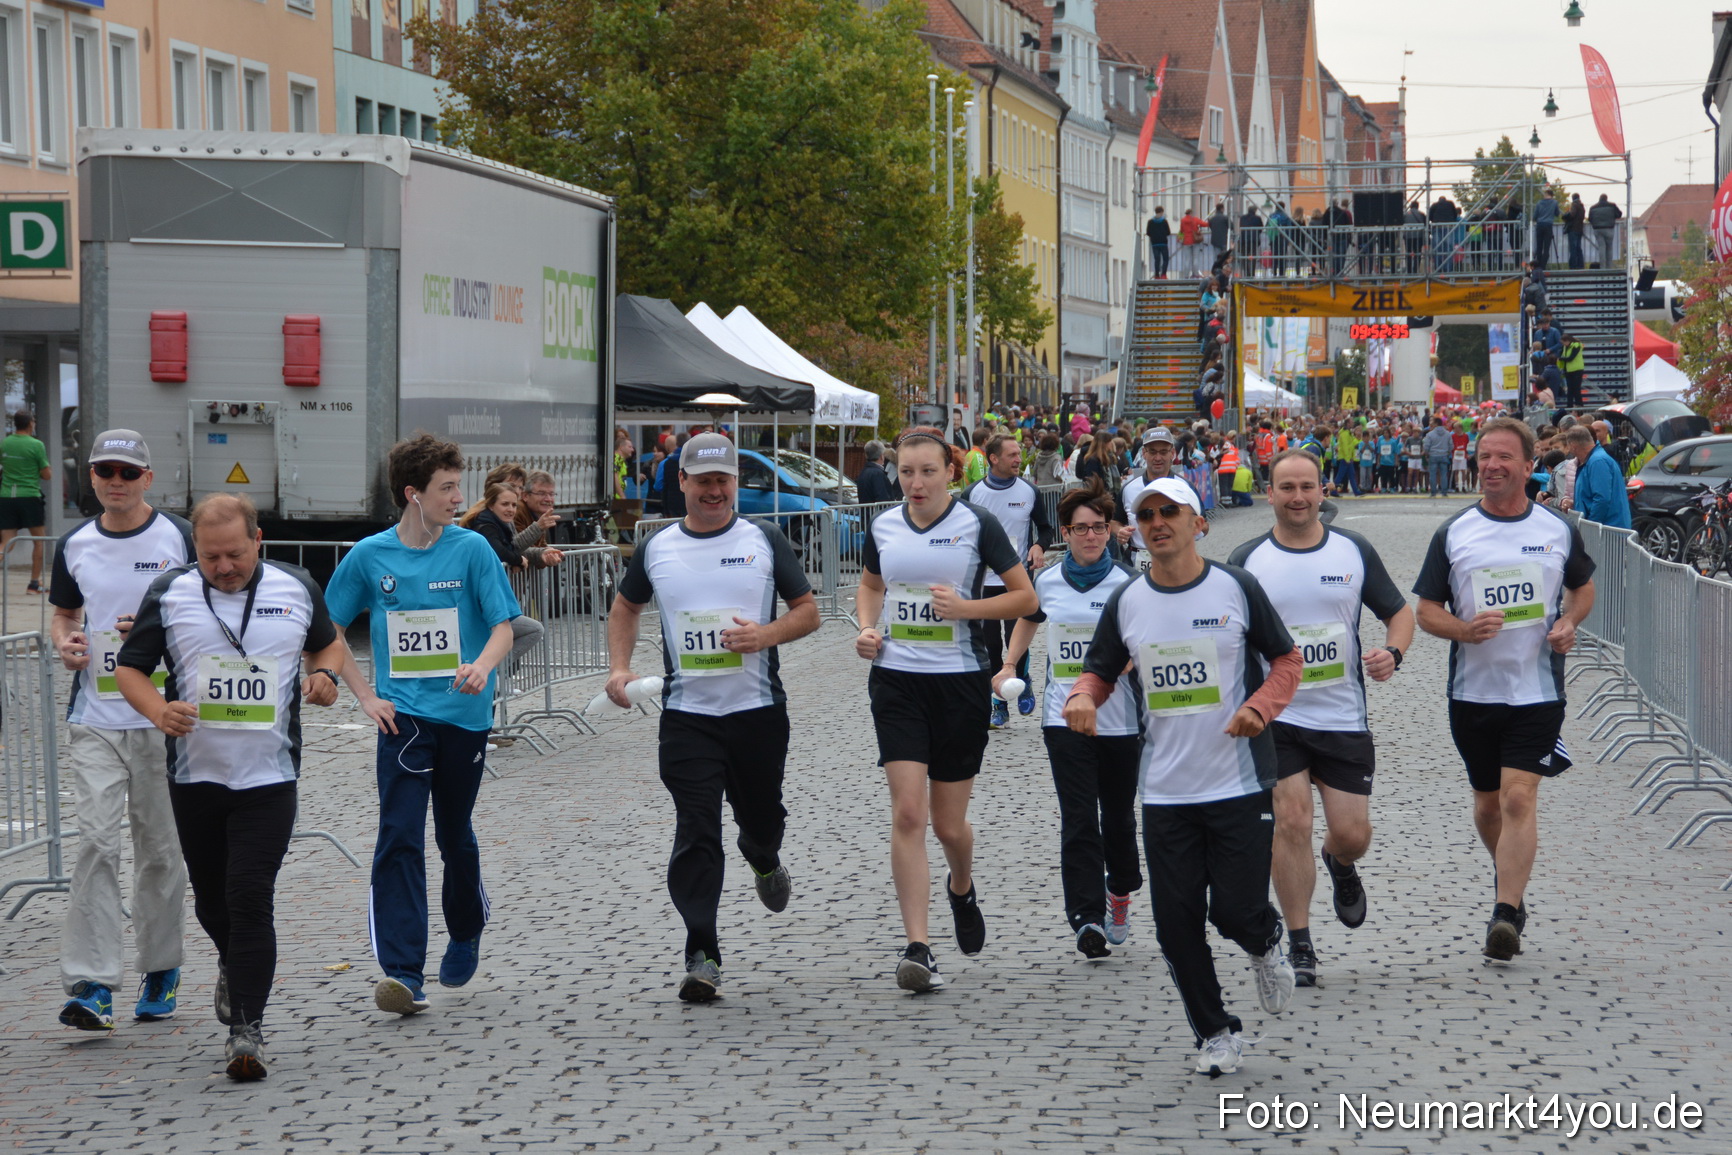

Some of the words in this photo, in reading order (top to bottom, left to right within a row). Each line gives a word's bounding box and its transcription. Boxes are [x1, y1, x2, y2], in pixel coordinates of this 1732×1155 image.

[9, 211, 58, 260] D
[422, 272, 450, 317] OFFICE
[454, 277, 492, 321] INDUSTRY
[494, 283, 524, 325] LOUNGE
[1351, 290, 1413, 312] ZIEL
[543, 277, 597, 352] BOCK
[1345, 394, 1354, 405] A
[300, 401, 317, 411] NM
[320, 403, 327, 411] x
[330, 402, 353, 411] 1106
[103, 439, 127, 447] swn
[697, 447, 719, 456] swn
[929, 537, 951, 545] swn
[1521, 545, 1545, 553] swn
[720, 556, 745, 565] swn
[134, 562, 159, 570] swn
[1320, 575, 1344, 583] swn
[428, 580, 462, 590] BOCK
[1484, 582, 1535, 607] 5079
[256, 607, 283, 615] swn
[1503, 609, 1528, 618] rlheinz
[1192, 617, 1219, 627] swn
[907, 628, 934, 637] Melanie
[398, 630, 448, 652] 5213
[1298, 641, 1337, 664] 006
[104, 651, 120, 673] 5
[694, 656, 725, 665] Christian
[1068, 665, 1084, 673] Kath
[1308, 669, 1325, 678] Jens
[1152, 661, 1207, 688] 5033
[208, 677, 266, 701] 5100
[1170, 693, 1193, 703] Vitaly
[226, 707, 248, 717] Peter
